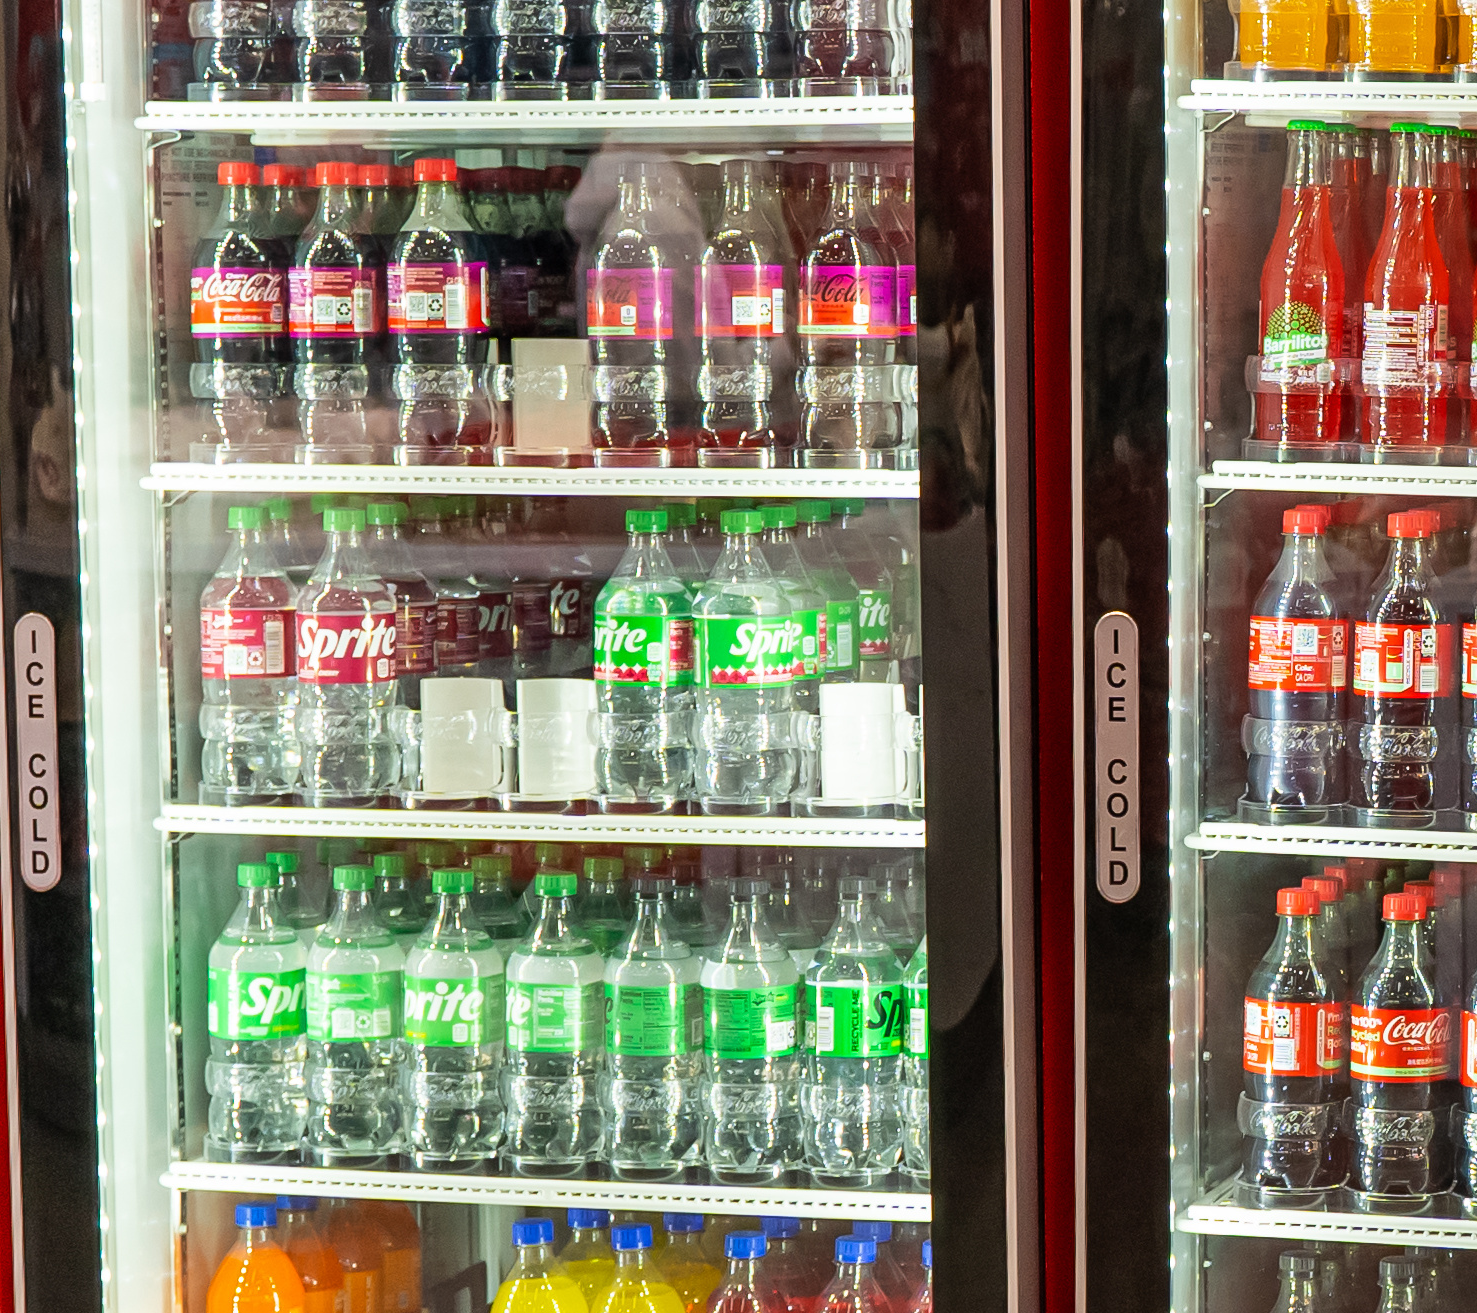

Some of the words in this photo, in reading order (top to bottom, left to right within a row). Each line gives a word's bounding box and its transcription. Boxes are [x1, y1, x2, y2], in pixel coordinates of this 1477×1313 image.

[1263, 334, 1328, 357] Barrilitos
[25, 629, 44, 719] ICE
[298, 613, 396, 660] Sprite
[1106, 628, 1127, 723] ICE
[26, 754, 50, 876] COLD
[1106, 758, 1129, 886] COLD
